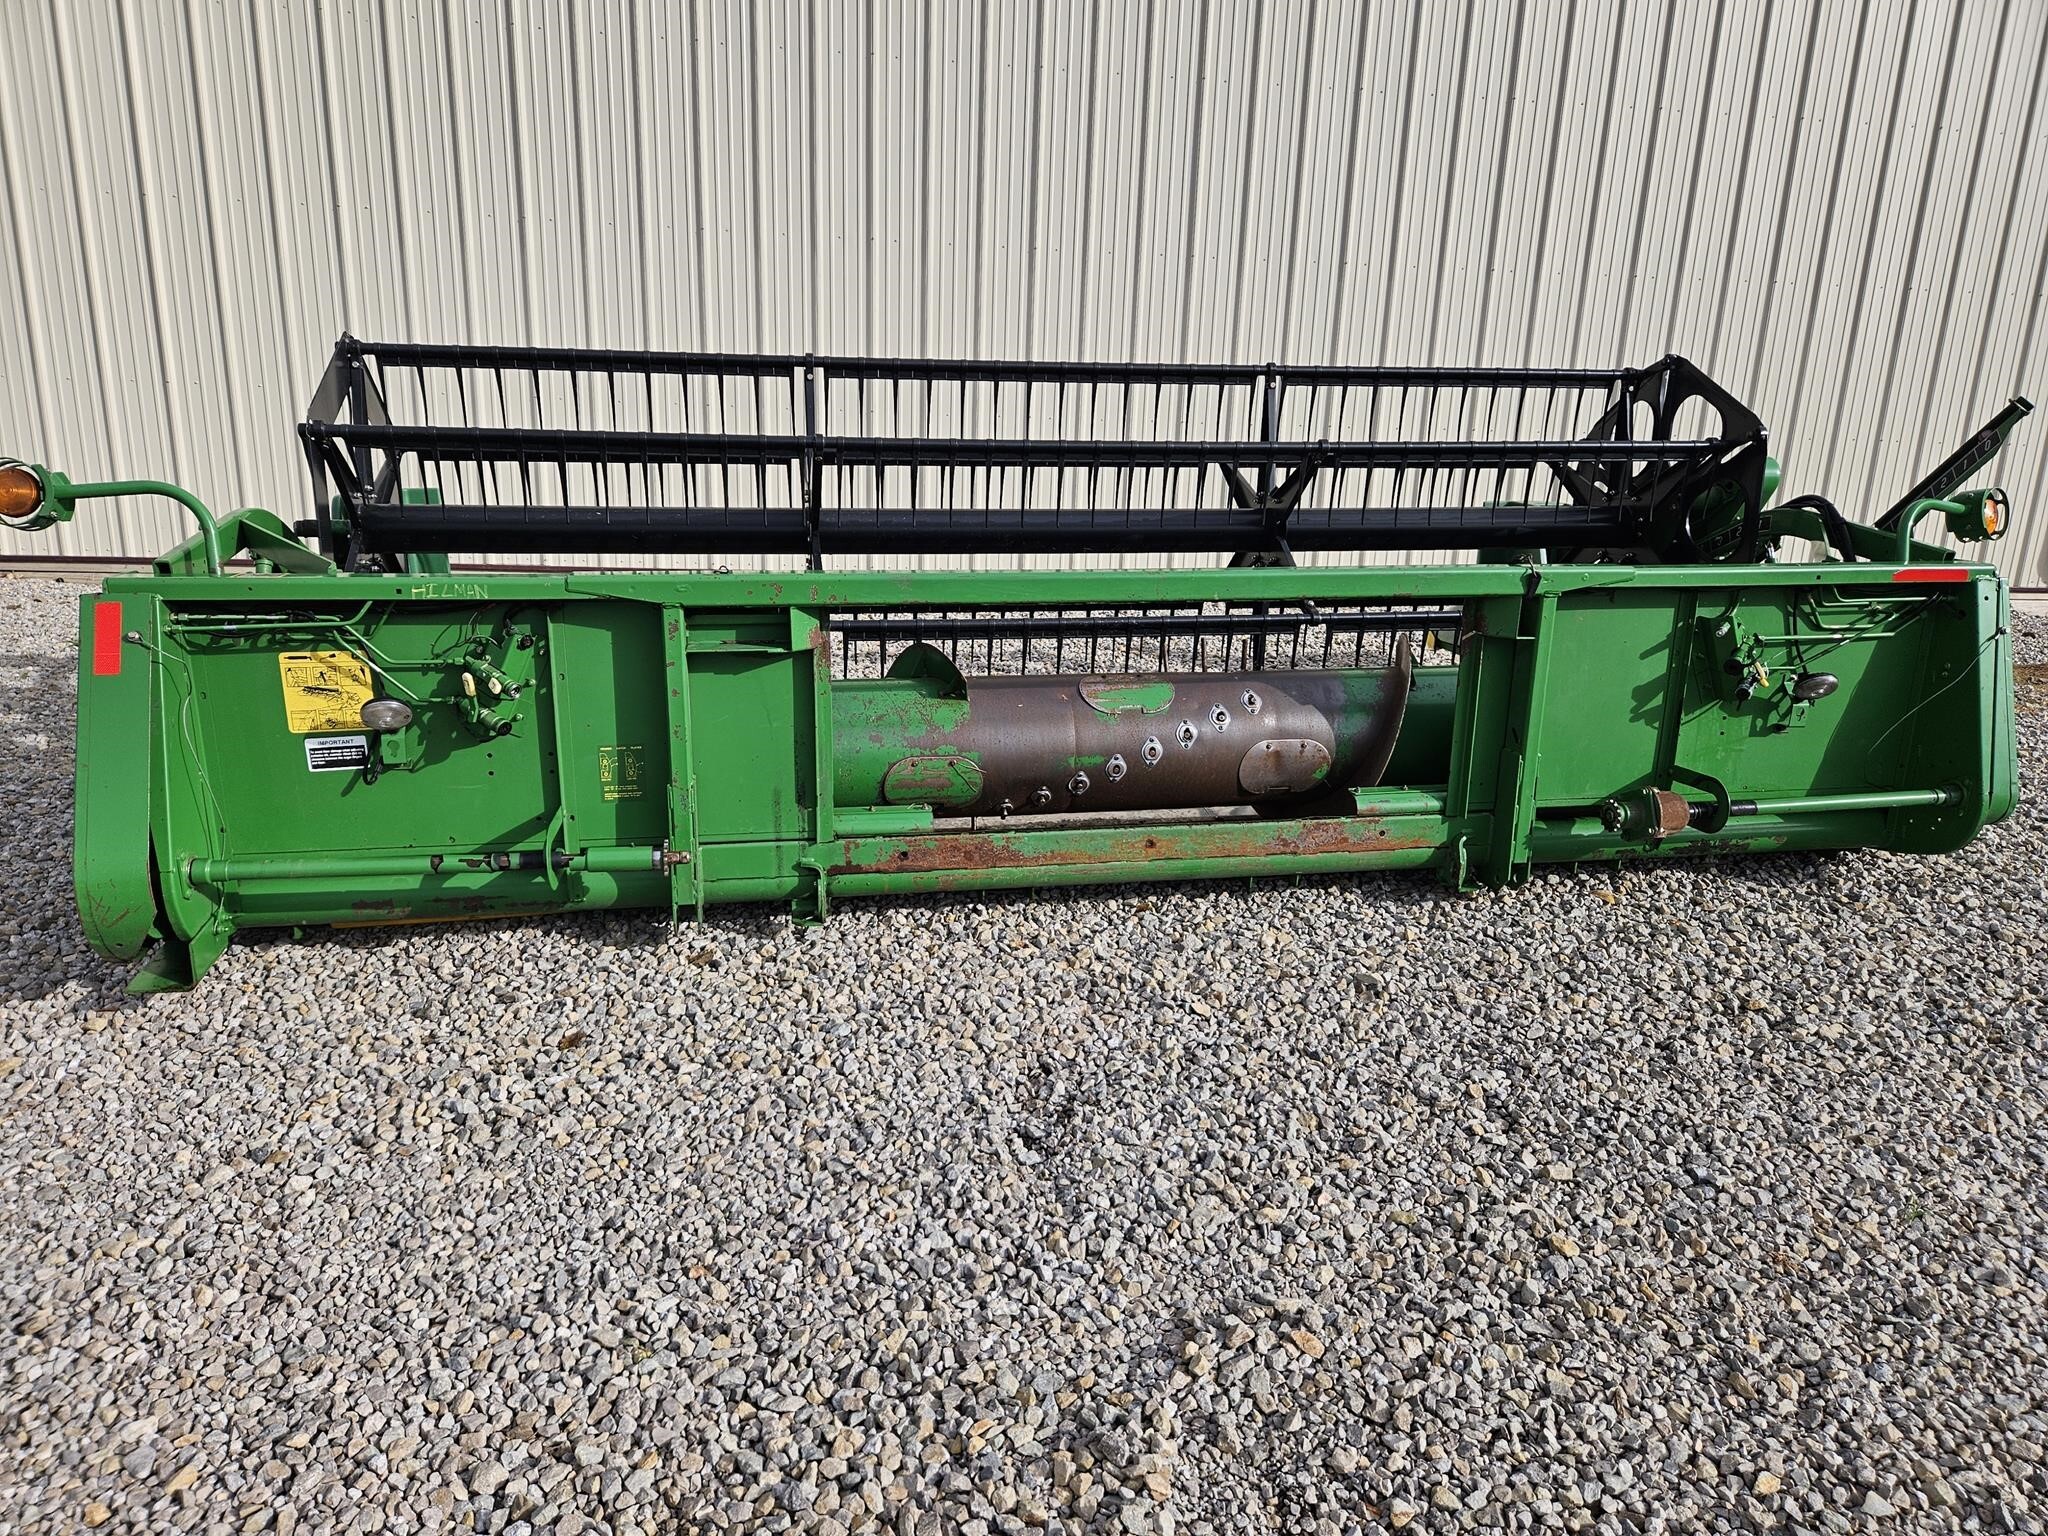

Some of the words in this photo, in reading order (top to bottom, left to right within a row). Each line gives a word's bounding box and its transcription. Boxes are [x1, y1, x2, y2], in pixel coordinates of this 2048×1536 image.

[1940, 477, 1948, 489] 2
[1984, 439, 1992, 451] 0
[412, 584, 488, 599] HILMAN
[317, 738, 354, 746] IMPORTANT
